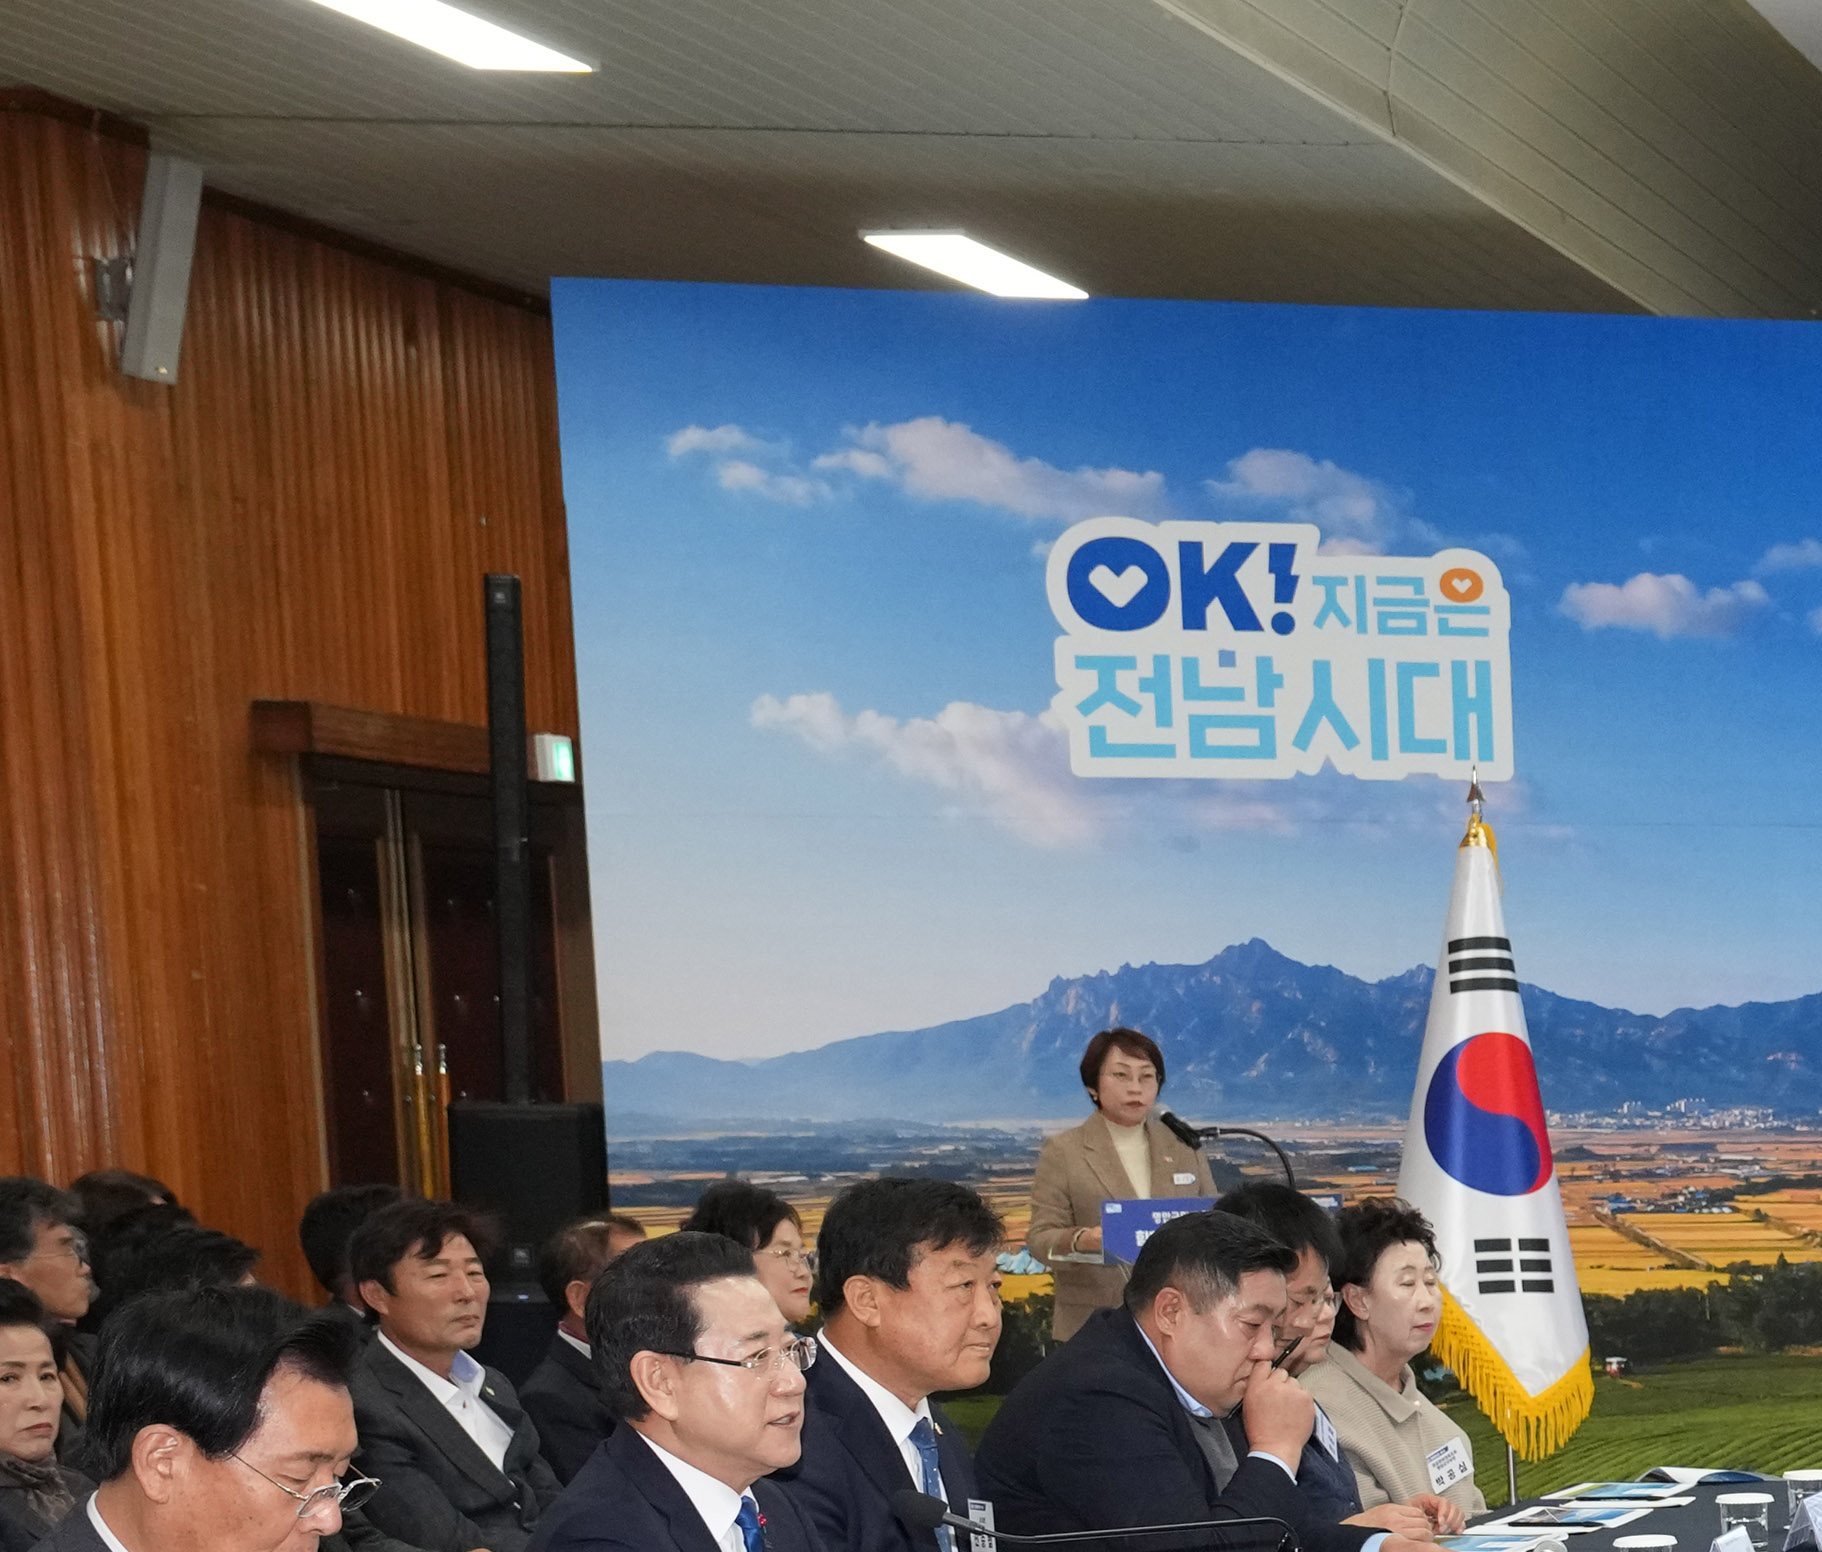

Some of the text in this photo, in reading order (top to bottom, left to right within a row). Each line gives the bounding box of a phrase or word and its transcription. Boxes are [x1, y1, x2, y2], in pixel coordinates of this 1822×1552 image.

[1066, 535, 1491, 638] OK! 지금은
[1073, 649, 1495, 763] 전남시대
